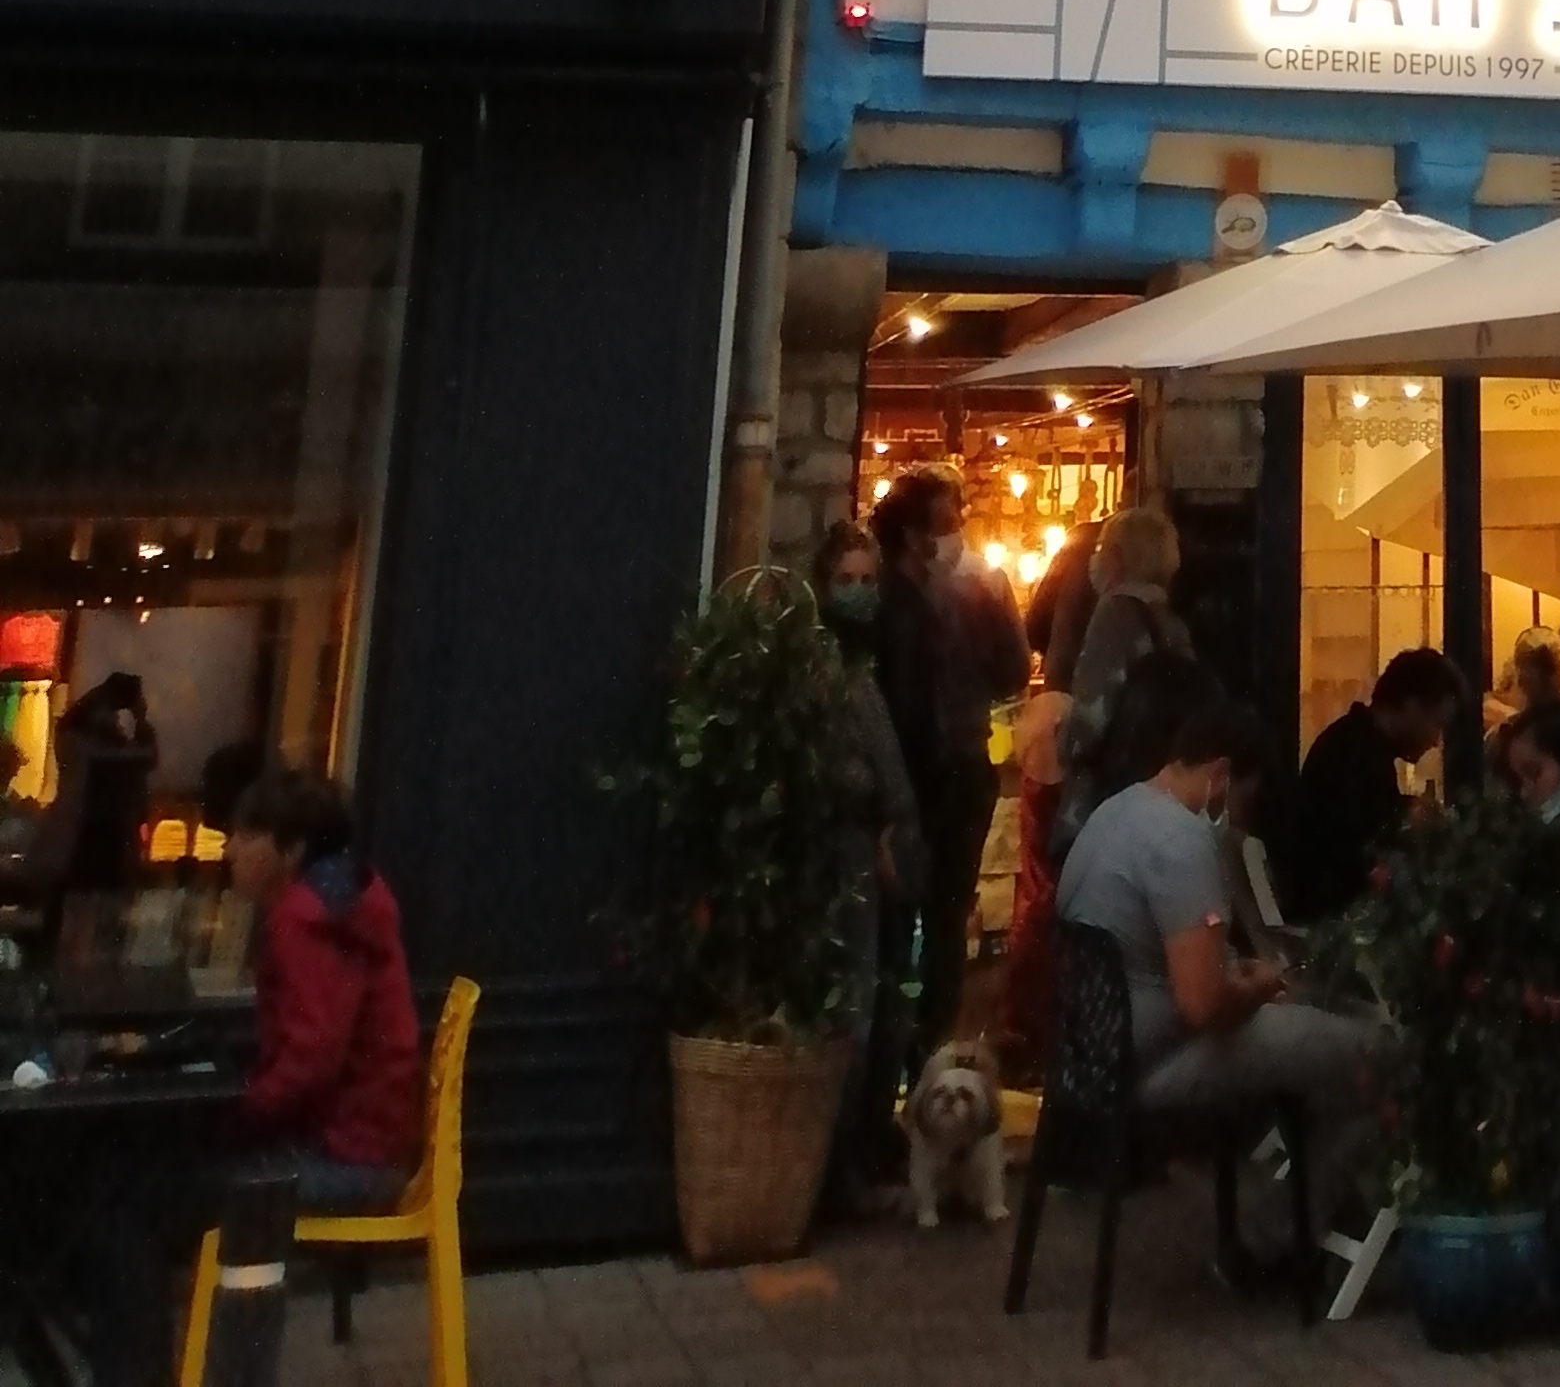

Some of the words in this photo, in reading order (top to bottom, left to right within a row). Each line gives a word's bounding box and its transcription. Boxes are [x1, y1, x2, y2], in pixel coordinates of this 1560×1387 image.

[1264, 44, 1382, 74] CRÊPERIE
[1393, 52, 1477, 78] DEPUIS
[1486, 56, 1545, 80] 1997
